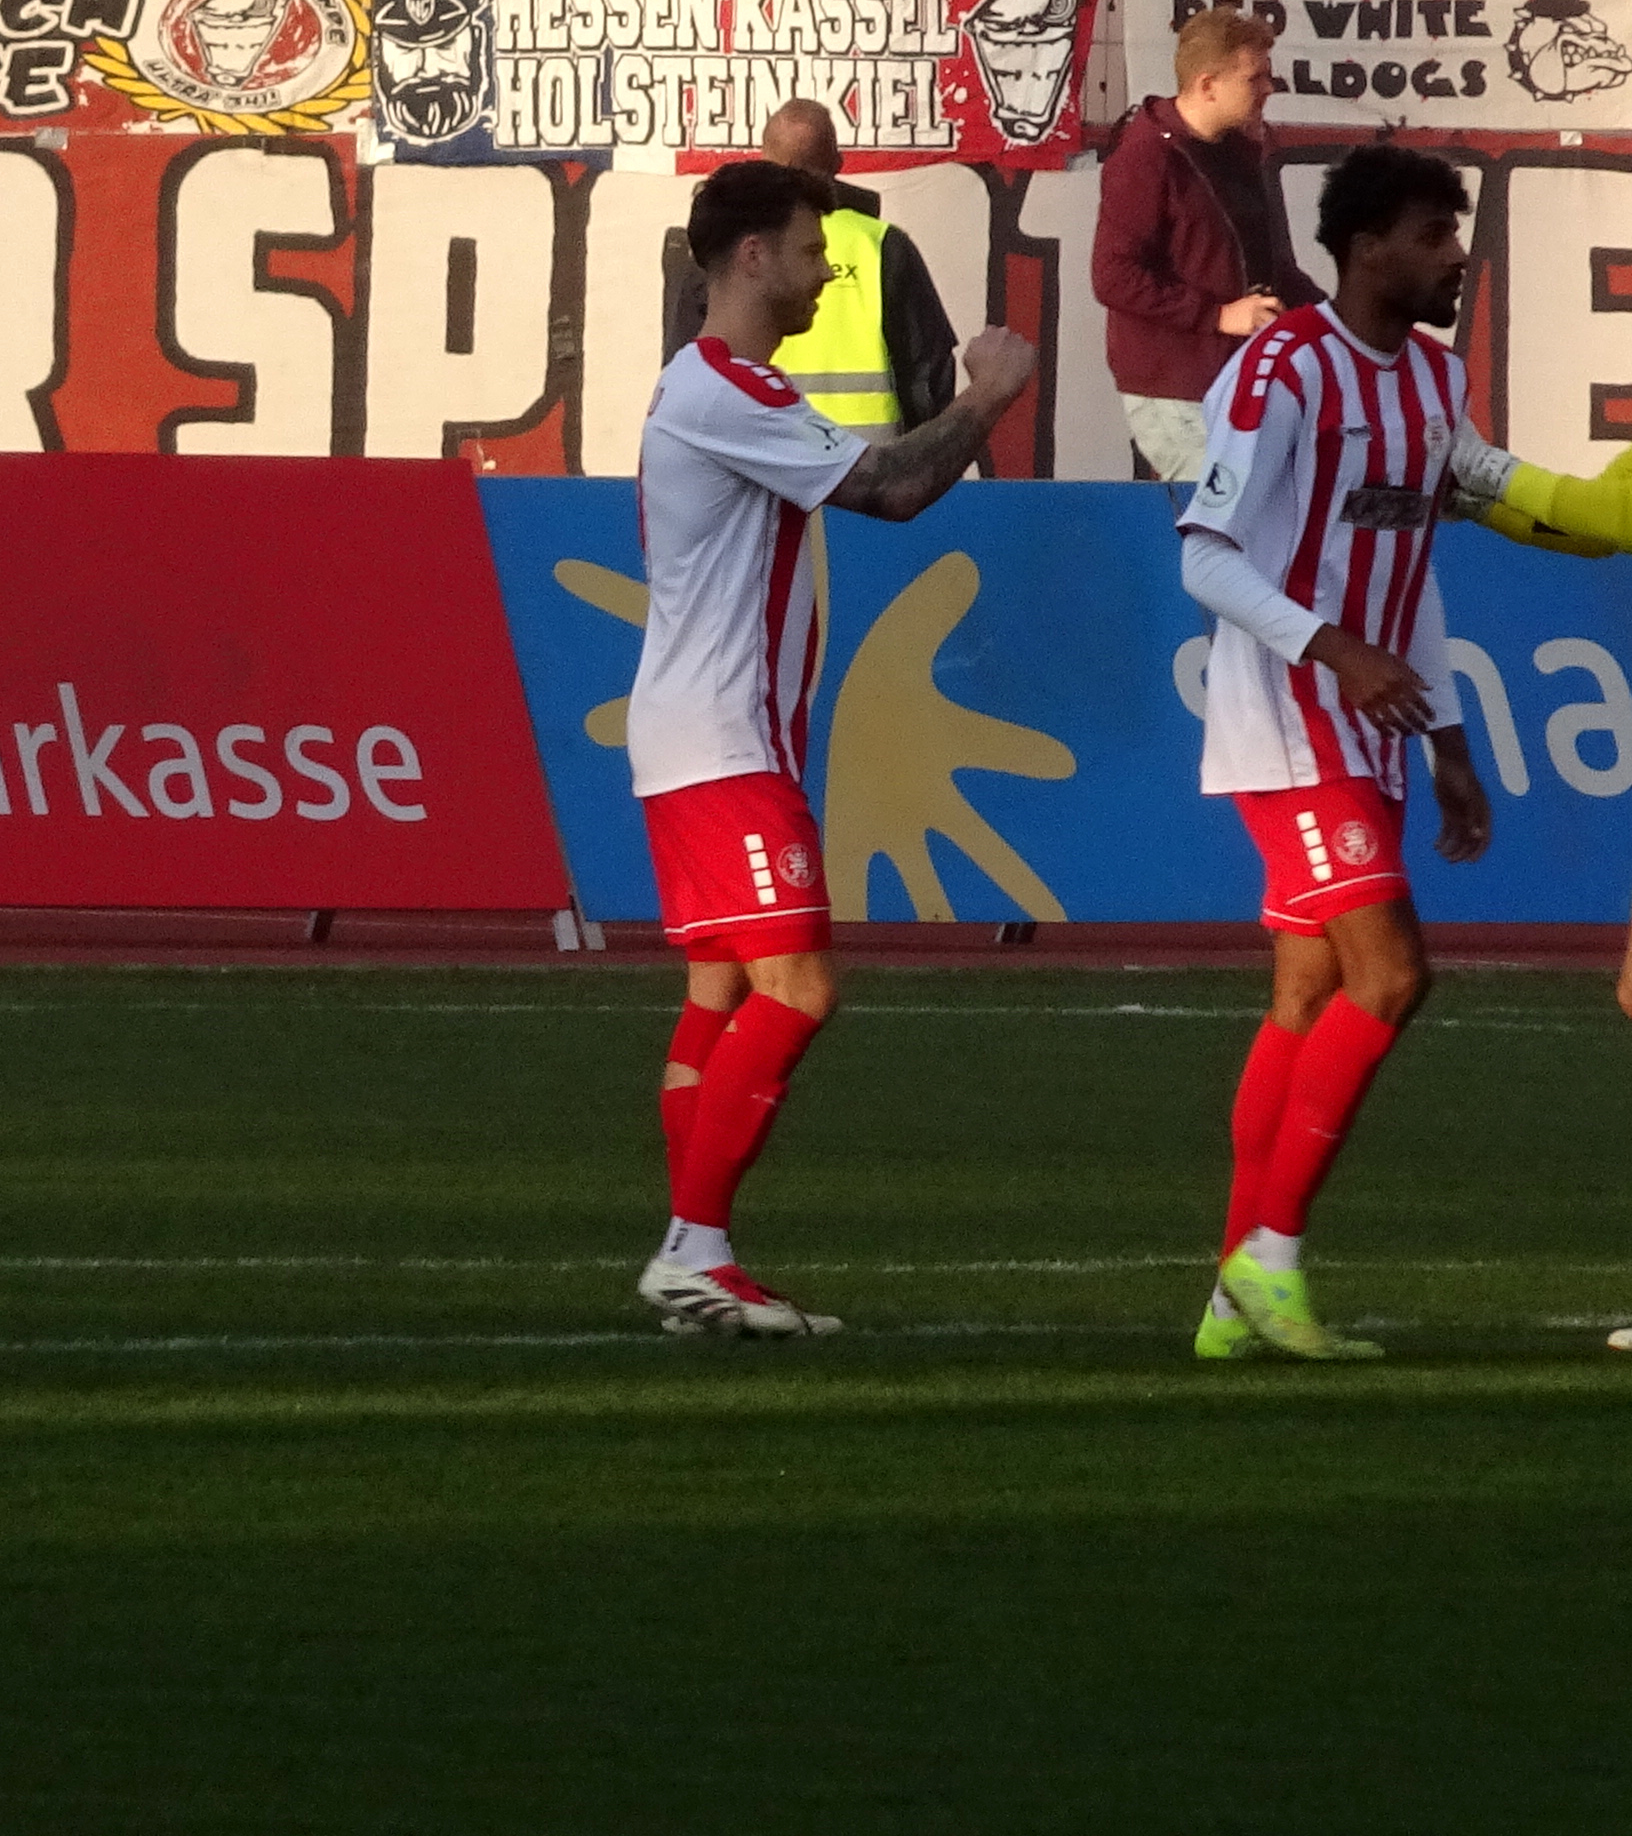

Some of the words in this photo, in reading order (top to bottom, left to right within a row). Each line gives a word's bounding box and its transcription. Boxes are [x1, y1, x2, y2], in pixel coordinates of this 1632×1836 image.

[494, 56, 799, 149] HOLSTEIN
[812, 59, 955, 150] KIEL
[1268, 58, 1488, 100] LDOGS
